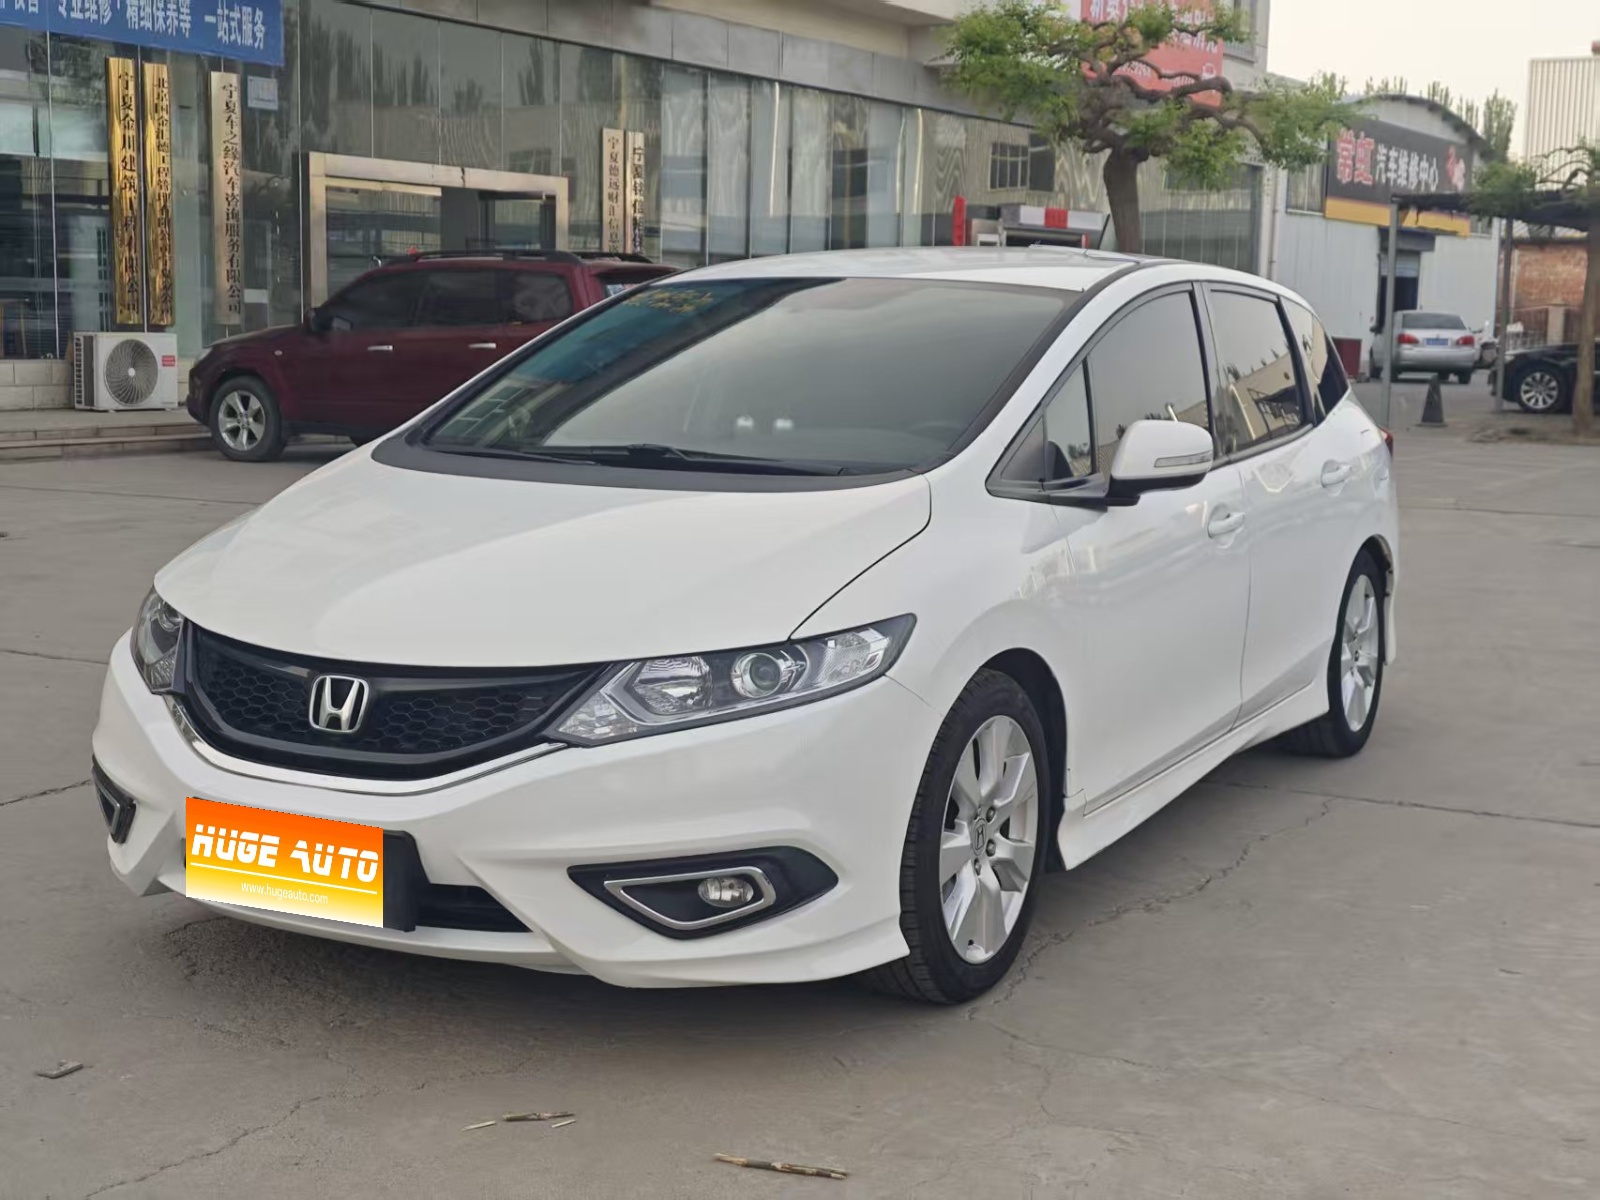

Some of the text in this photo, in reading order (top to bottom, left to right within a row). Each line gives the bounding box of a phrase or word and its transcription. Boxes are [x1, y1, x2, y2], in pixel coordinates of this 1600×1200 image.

[204, 0, 267, 50] 一站式服务
[1375, 143, 1439, 192] 汽车维修中心
